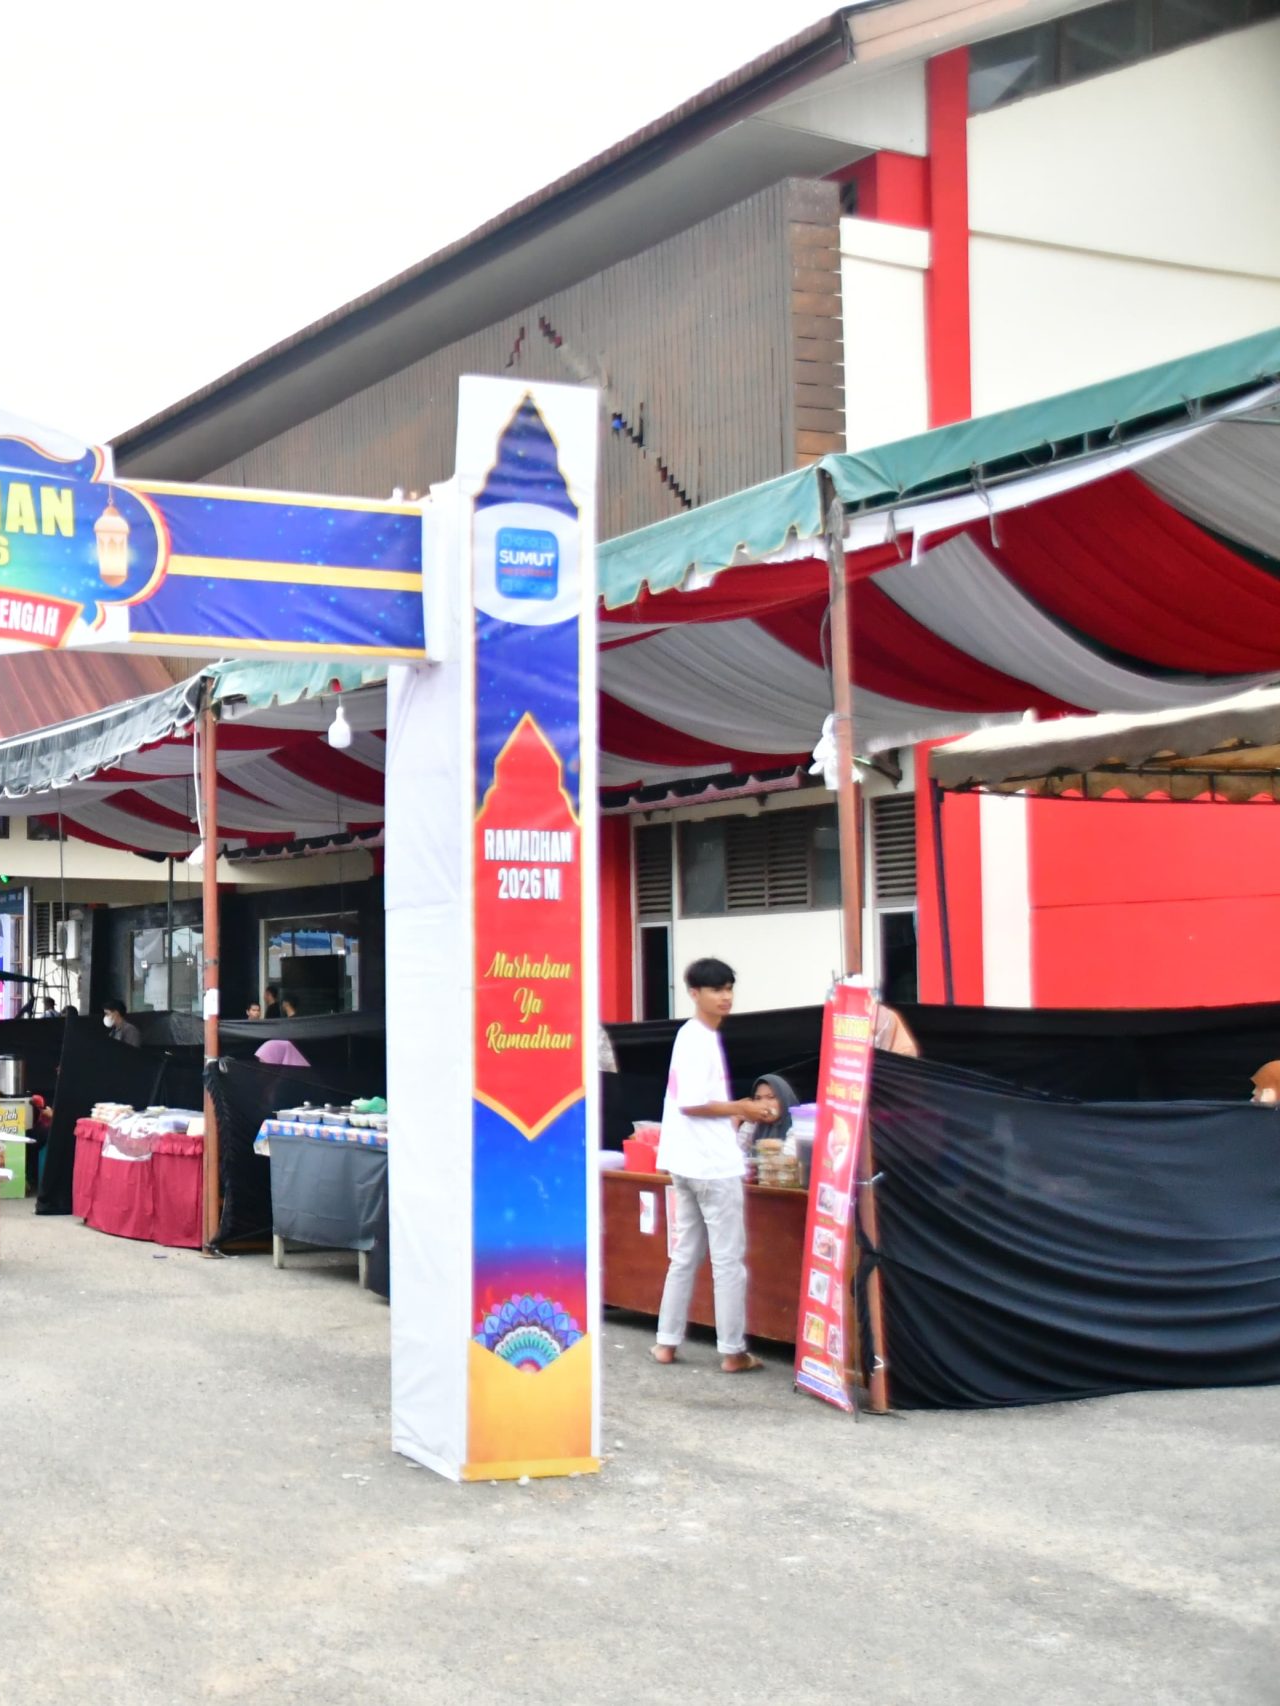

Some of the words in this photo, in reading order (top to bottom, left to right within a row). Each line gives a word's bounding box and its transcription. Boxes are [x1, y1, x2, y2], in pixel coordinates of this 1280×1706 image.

[499, 549, 555, 567] SUMUT
[483, 828, 573, 863] RAMADHAN
[497, 868, 542, 900] 2026
[543, 869, 560, 900] M
[484, 951, 571, 980] Marhaban
[513, 986, 543, 1023] Ya
[486, 1021, 573, 1054] Ramadhan
